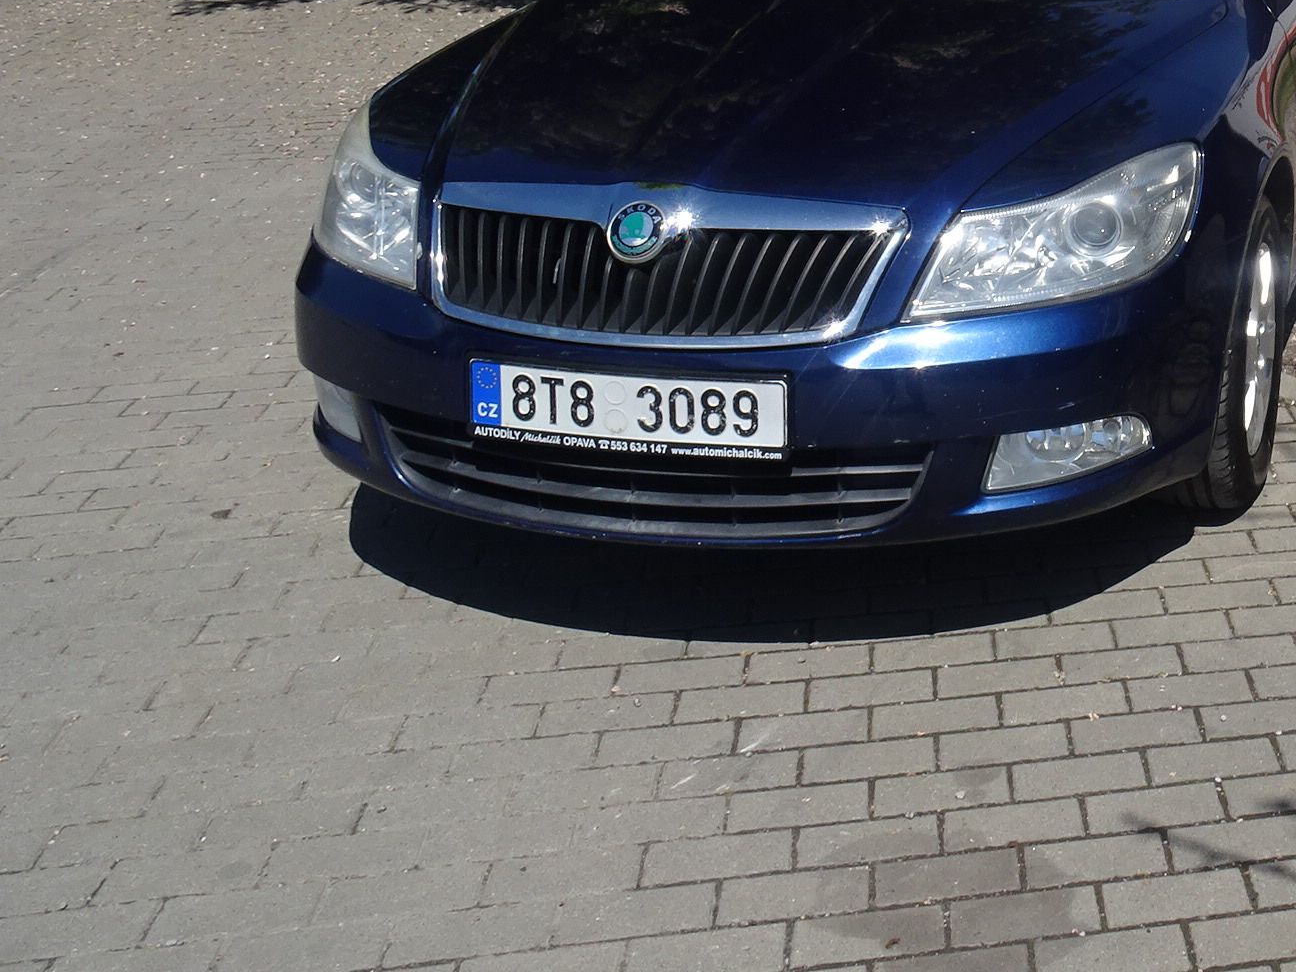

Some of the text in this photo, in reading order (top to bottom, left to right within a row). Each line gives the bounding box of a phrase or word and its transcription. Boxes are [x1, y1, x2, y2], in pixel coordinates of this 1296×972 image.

[477, 402, 499, 419] CZ
[511, 374, 760, 438] 8T8 3089
[563, 436, 597, 448] OPAVA
[610, 440, 628, 451] 553
[629, 442, 648, 453] 634
[649, 444, 668, 454] 147
[670, 446, 783, 460] www.automichalcik.com
